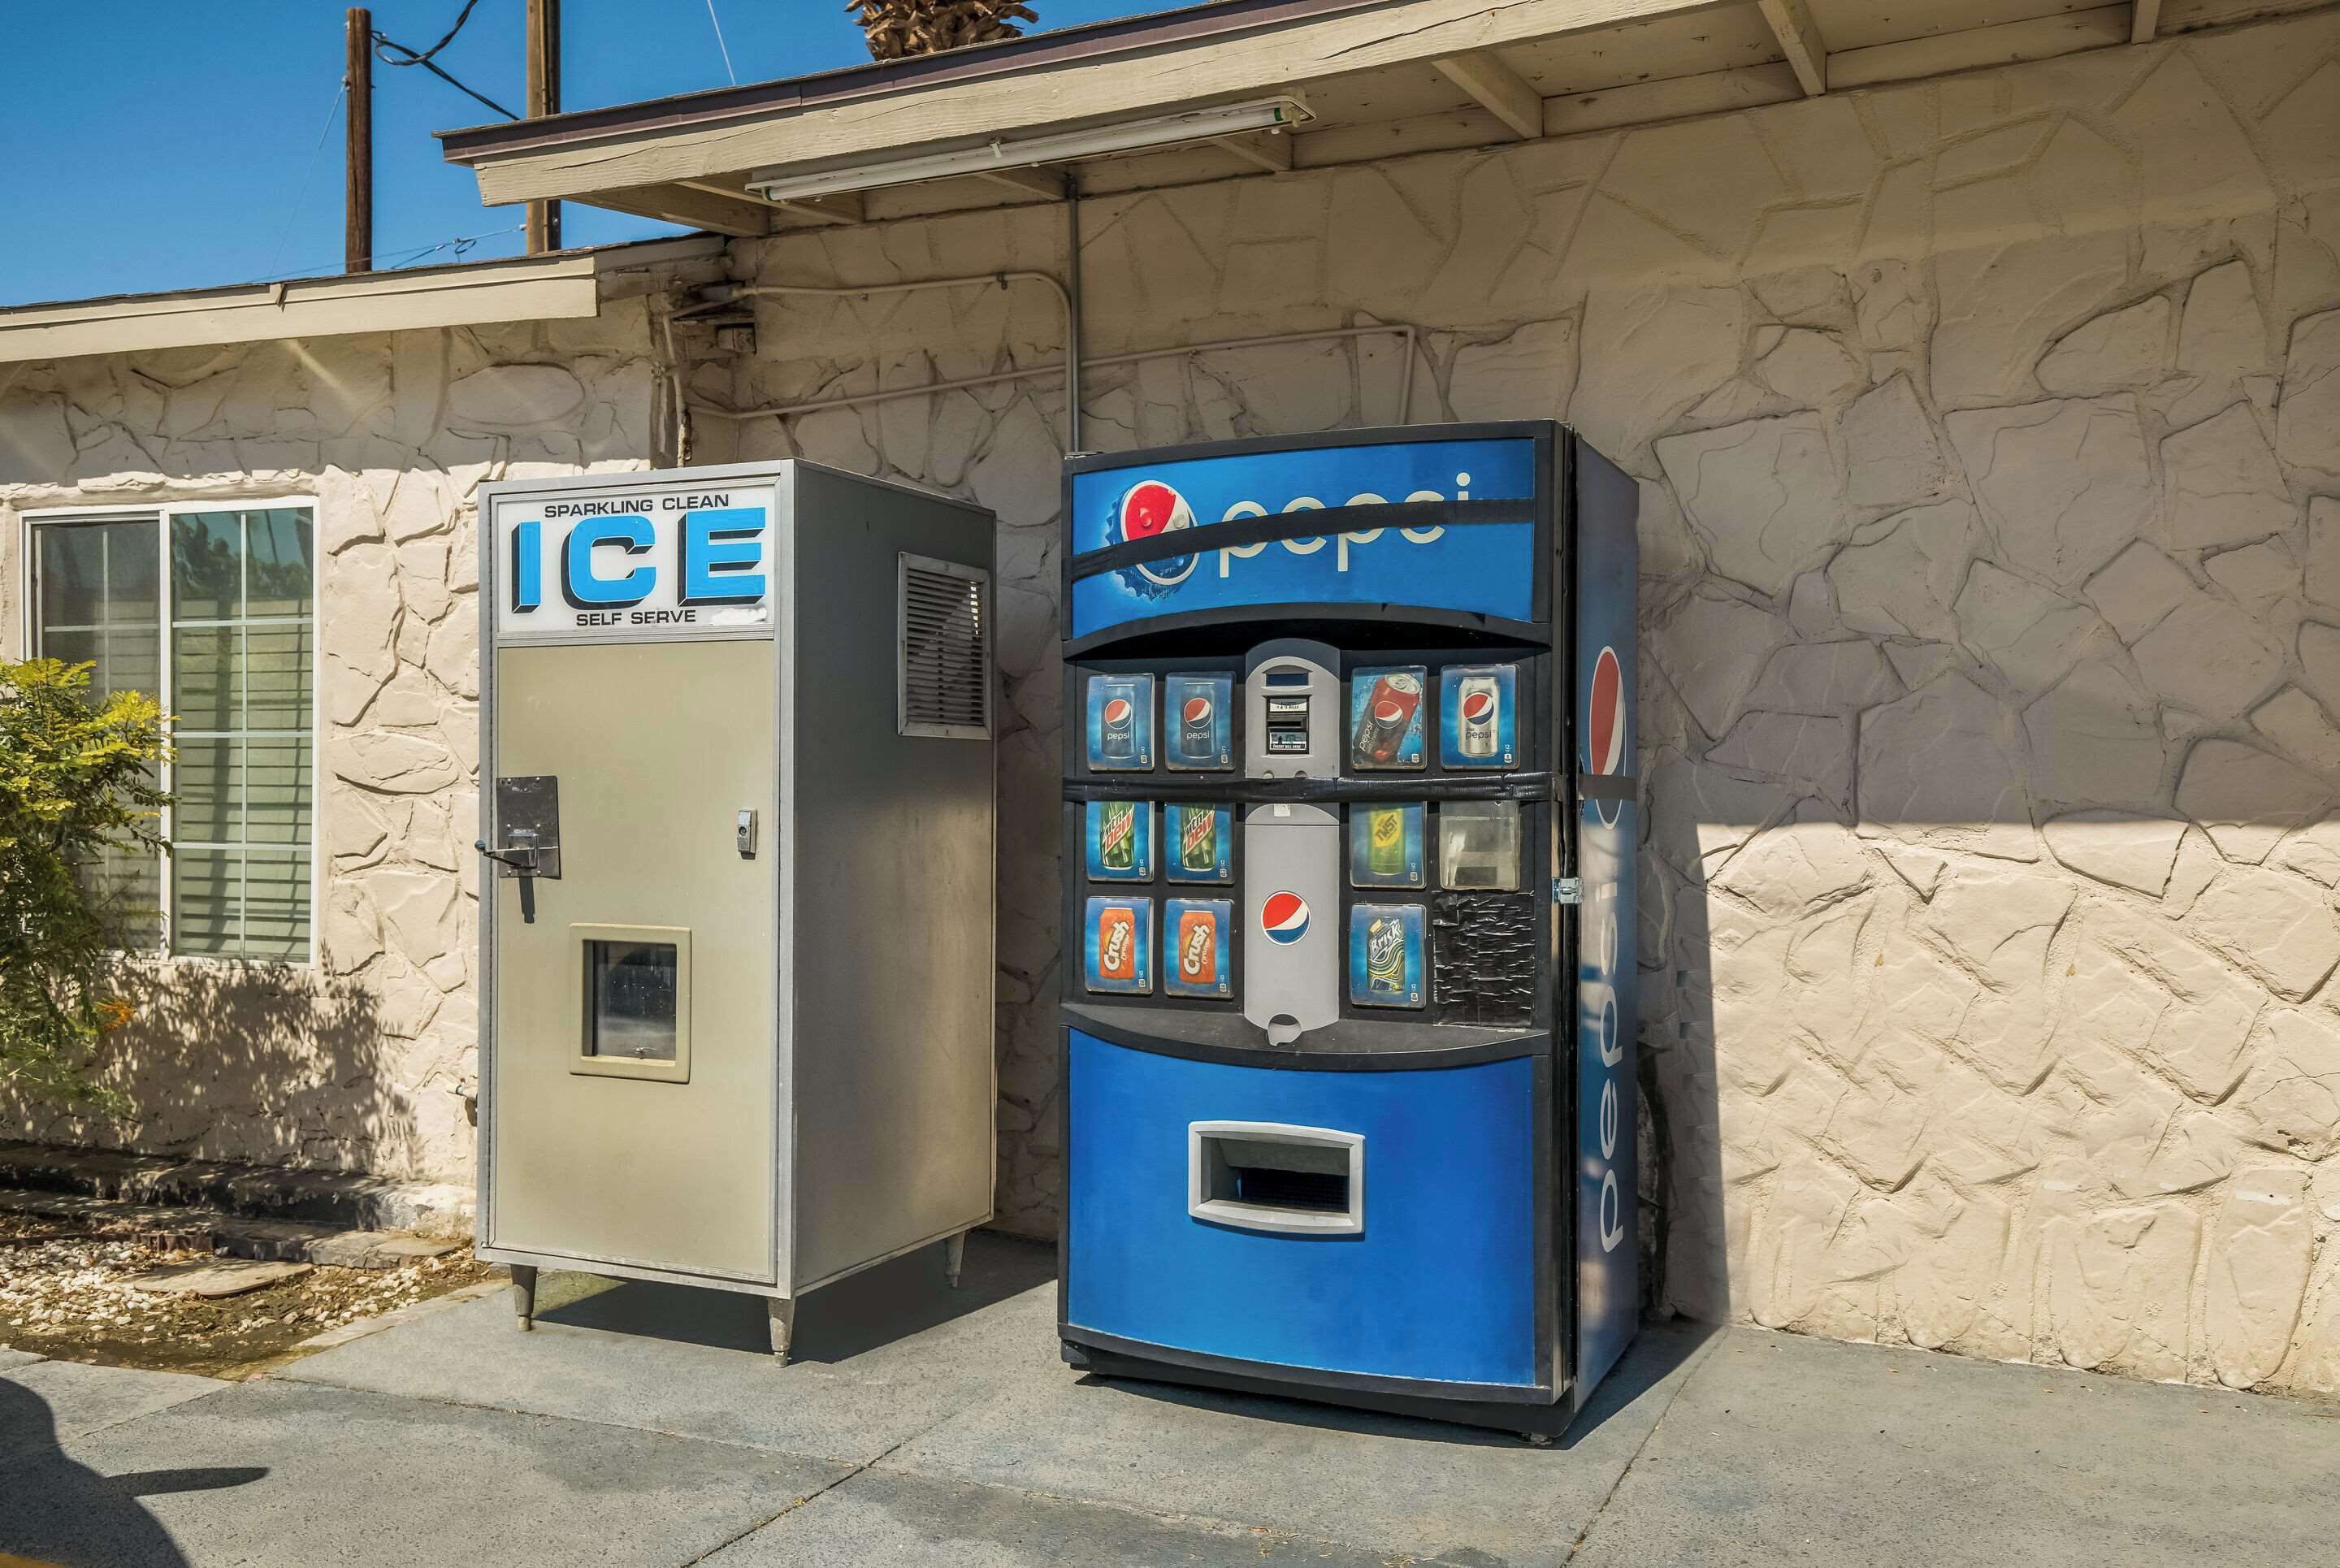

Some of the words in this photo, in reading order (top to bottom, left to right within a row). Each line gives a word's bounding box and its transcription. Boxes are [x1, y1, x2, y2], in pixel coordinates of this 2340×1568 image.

[544, 499, 653, 518] SPARKLING
[662, 494, 729, 511] CLEAN
[511, 507, 766, 614] ICE
[576, 612, 622, 626] SELF
[630, 609, 696, 625] SERVE
[1107, 731, 1130, 741] pepsi
[1186, 730, 1210, 740] pepsi
[1359, 721, 1373, 752] pepsi
[1465, 730, 1492, 741] pepsi
[1104, 920, 1130, 971] Crush
[1183, 924, 1211, 975] Crush
[1596, 881, 1624, 1254] pepsi
